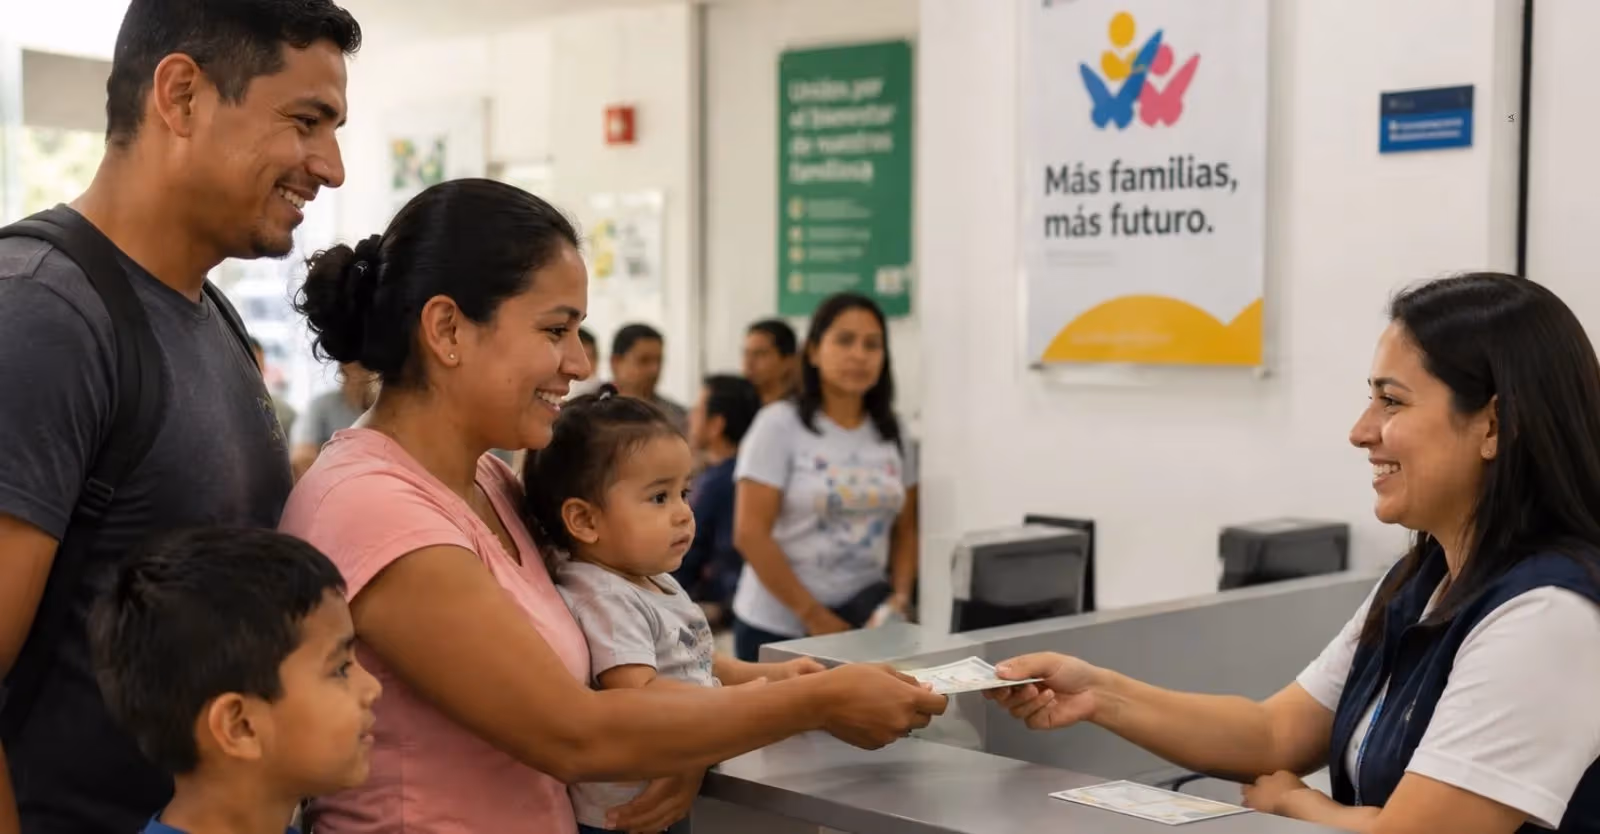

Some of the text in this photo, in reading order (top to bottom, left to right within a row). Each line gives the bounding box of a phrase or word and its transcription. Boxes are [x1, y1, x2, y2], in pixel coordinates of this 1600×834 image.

[1044, 155, 1239, 195] Más familias,
[1044, 203, 1215, 238] más futuro.
